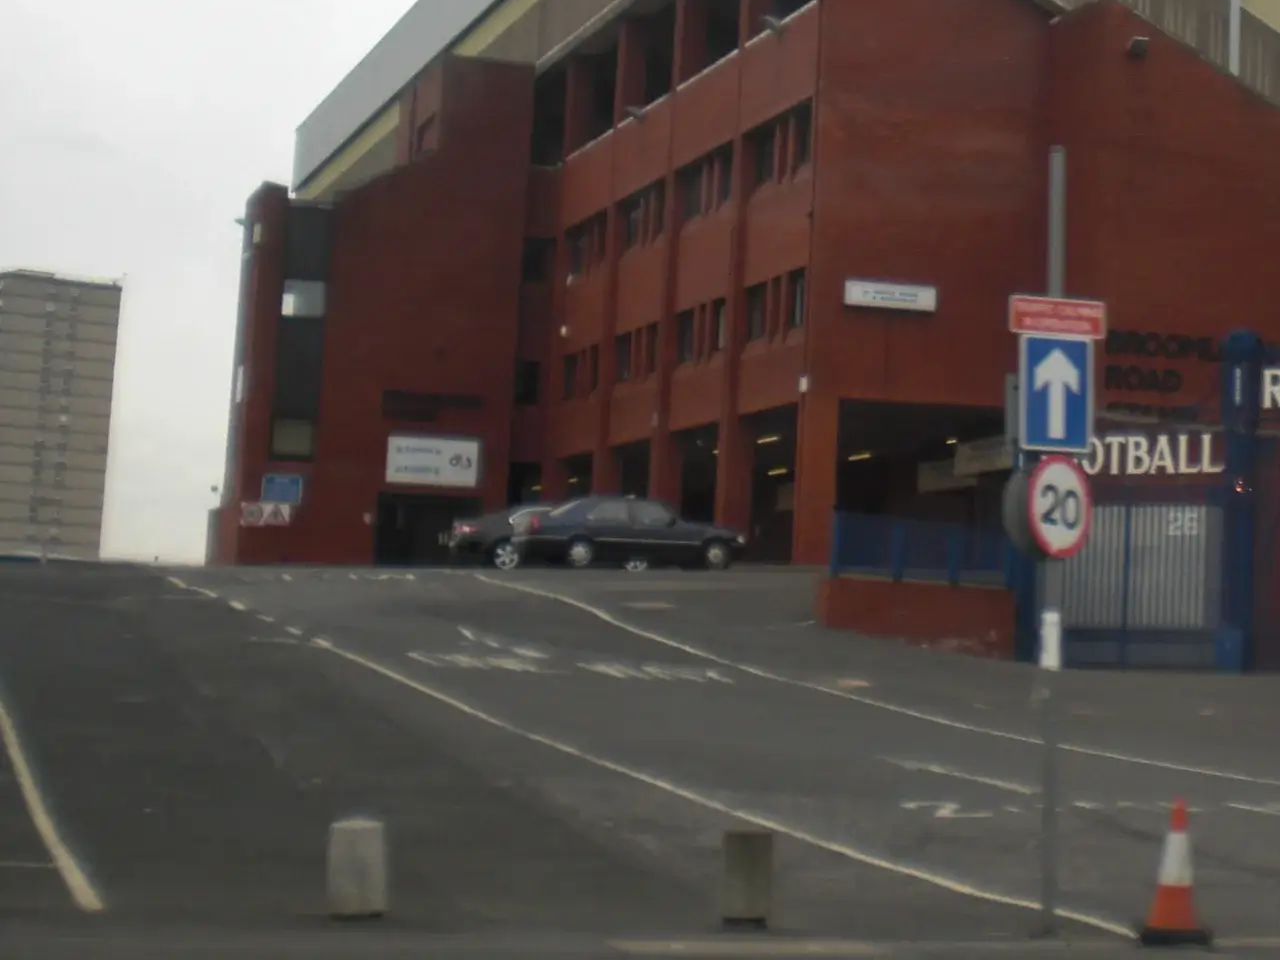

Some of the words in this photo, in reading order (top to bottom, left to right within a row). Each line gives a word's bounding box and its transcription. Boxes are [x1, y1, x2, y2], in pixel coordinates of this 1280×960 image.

[1104, 365, 1182, 393] ROAD
[1079, 434, 1225, 475] OTBALL
[1040, 483, 1080, 530] 20
